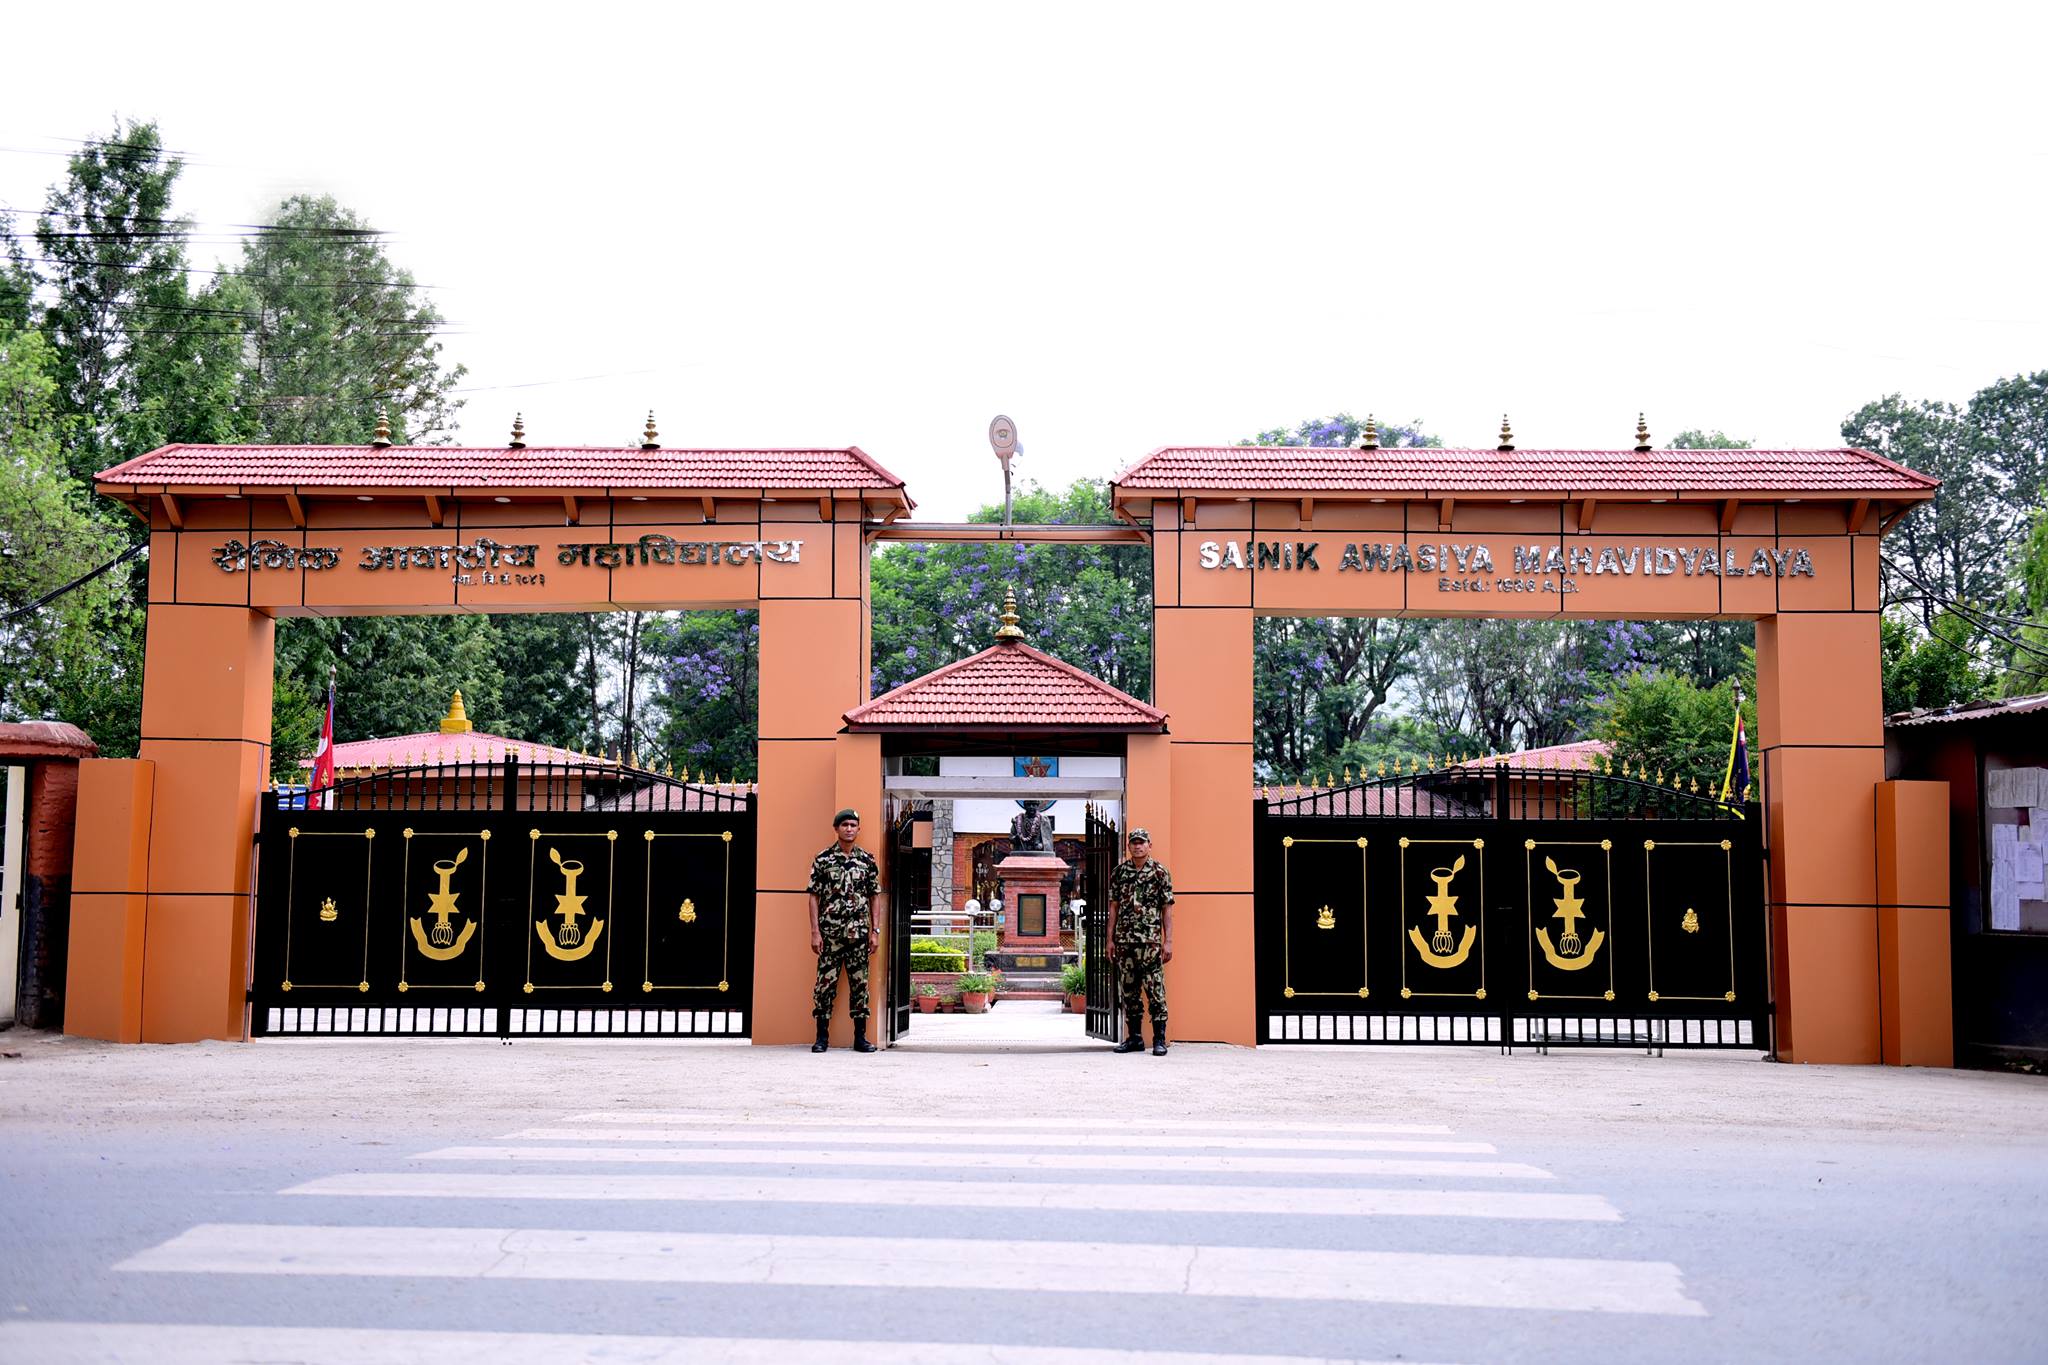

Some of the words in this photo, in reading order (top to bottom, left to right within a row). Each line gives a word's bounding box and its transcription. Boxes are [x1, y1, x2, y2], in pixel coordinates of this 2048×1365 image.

[211, 539, 343, 572] सैनिक
[358, 537, 539, 570] आवासीय
[557, 533, 804, 567] महाविद्यालय
[1199, 540, 1320, 571] SAINIK
[1338, 543, 1494, 574] AWASIYA
[1514, 546, 1816, 578] MAHAVIDYALAYA
